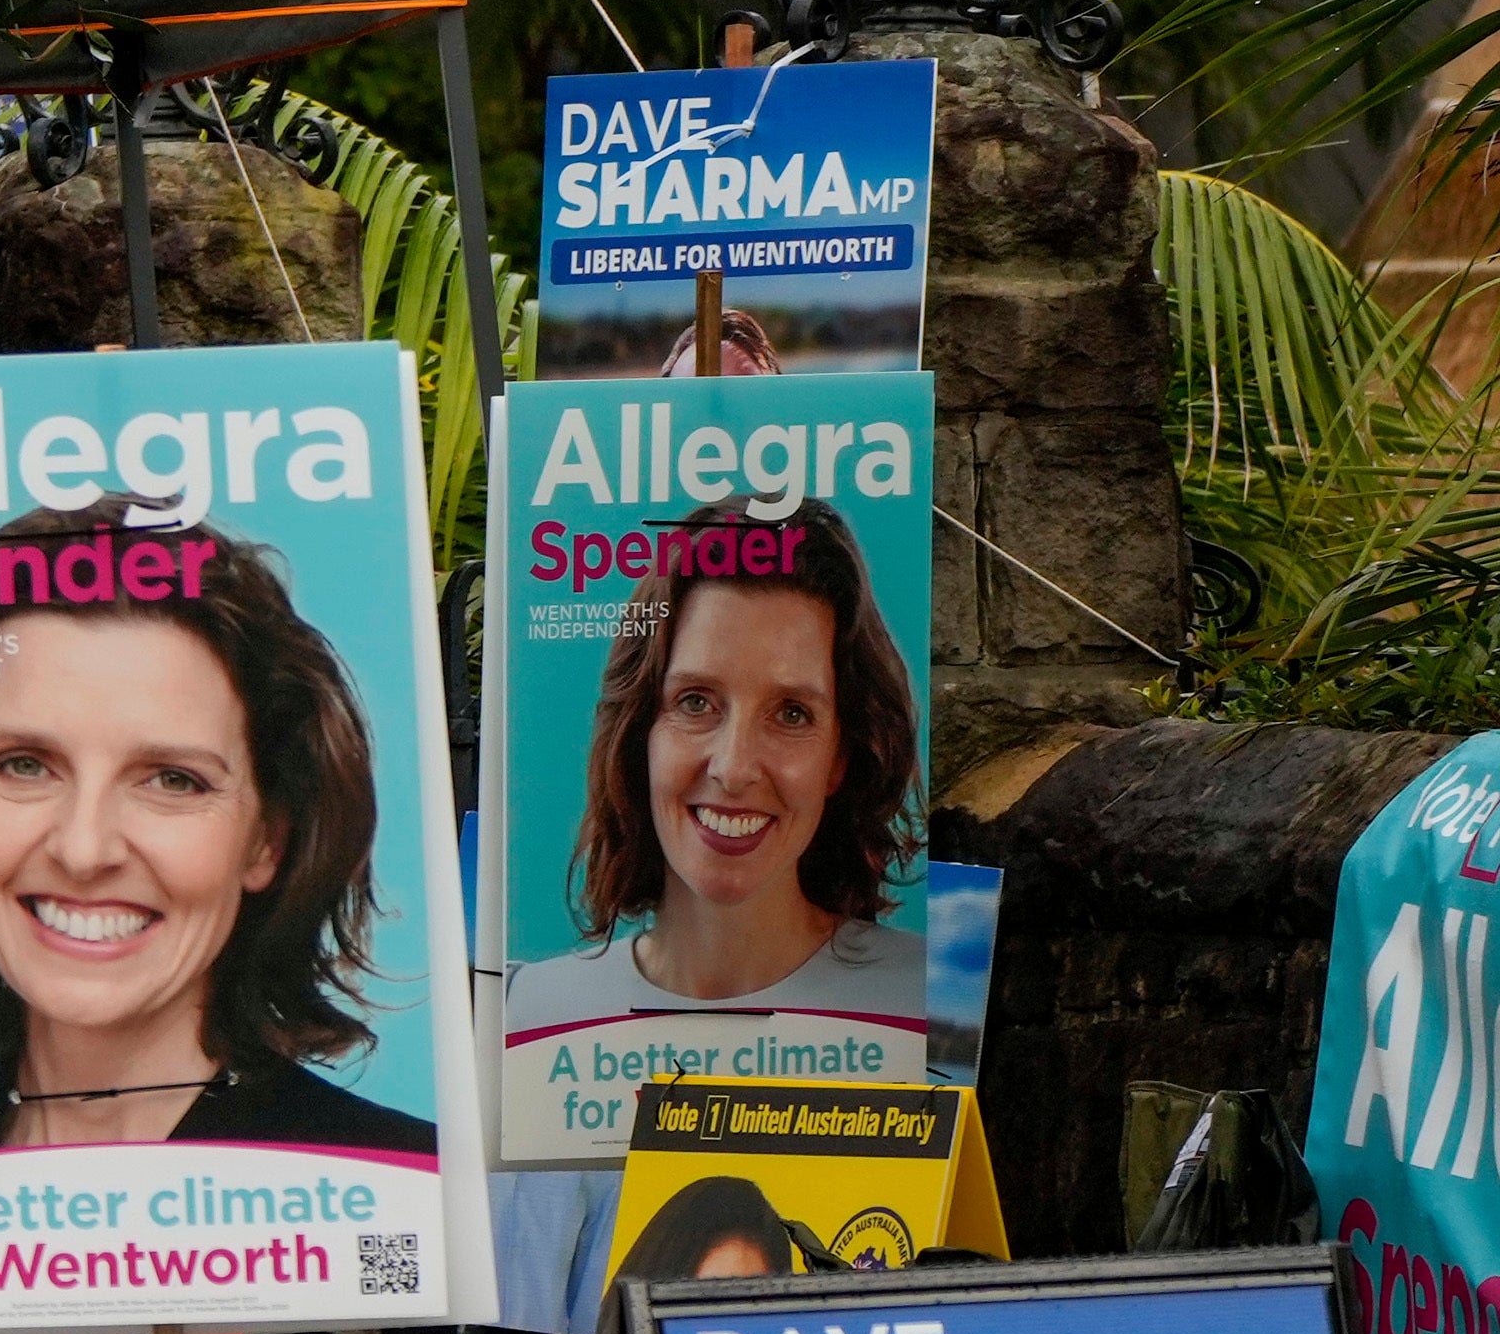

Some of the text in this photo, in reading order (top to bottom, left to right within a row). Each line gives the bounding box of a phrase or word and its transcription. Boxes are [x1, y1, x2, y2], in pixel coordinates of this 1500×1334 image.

[561, 97, 711, 156] DAVE
[555, 151, 915, 229] SHARMA MP
[570, 235, 894, 275] LIBERAL FOR WENTWORTH
[530, 402, 912, 521] Allegra
[530, 515, 806, 593] Spender
[528, 620, 658, 640] INDEPENDENT
[530, 601, 670, 621] WENTWORTH'S
[548, 1036, 885, 1083] A better climate
[563, 1090, 622, 1131] for
[657, 1100, 697, 1132] Vote
[730, 1102, 791, 1136] United
[793, 1105, 877, 1138] Australia
[882, 1107, 936, 1146] Party
[147, 1176, 376, 1228] climate
[855, 1217, 899, 1239] AUSTRALIA
